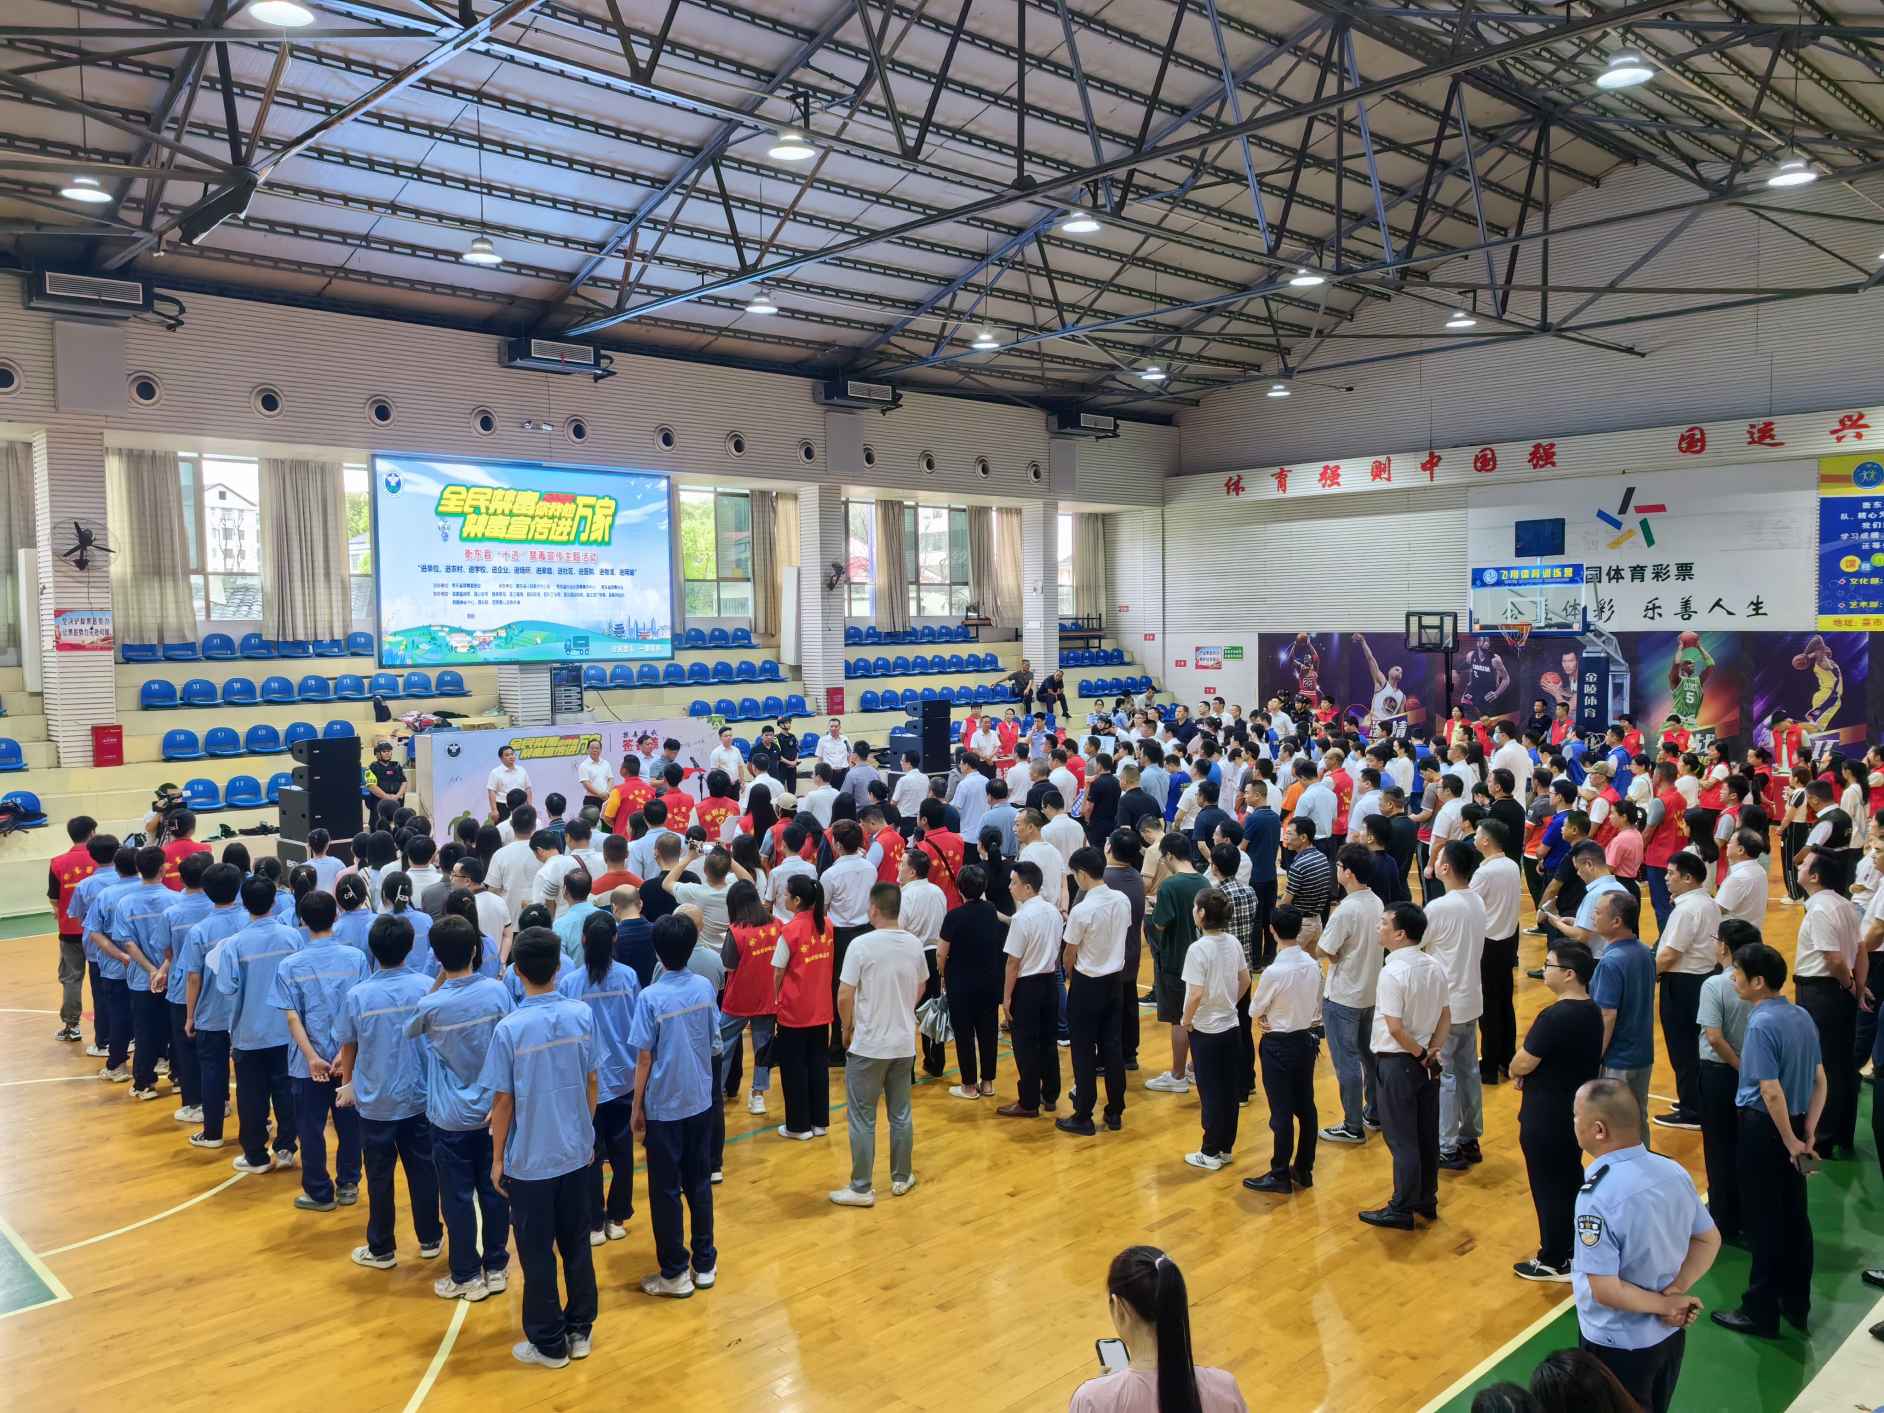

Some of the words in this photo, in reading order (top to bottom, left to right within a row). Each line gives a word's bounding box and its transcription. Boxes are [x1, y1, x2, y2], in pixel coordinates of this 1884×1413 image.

[1224, 442, 1557, 497] 体育强则中国强
[1678, 411, 1871, 455] 国运兴
[1643, 594, 1768, 621] 乐善人生
[1685, 691, 1695, 704] 5
